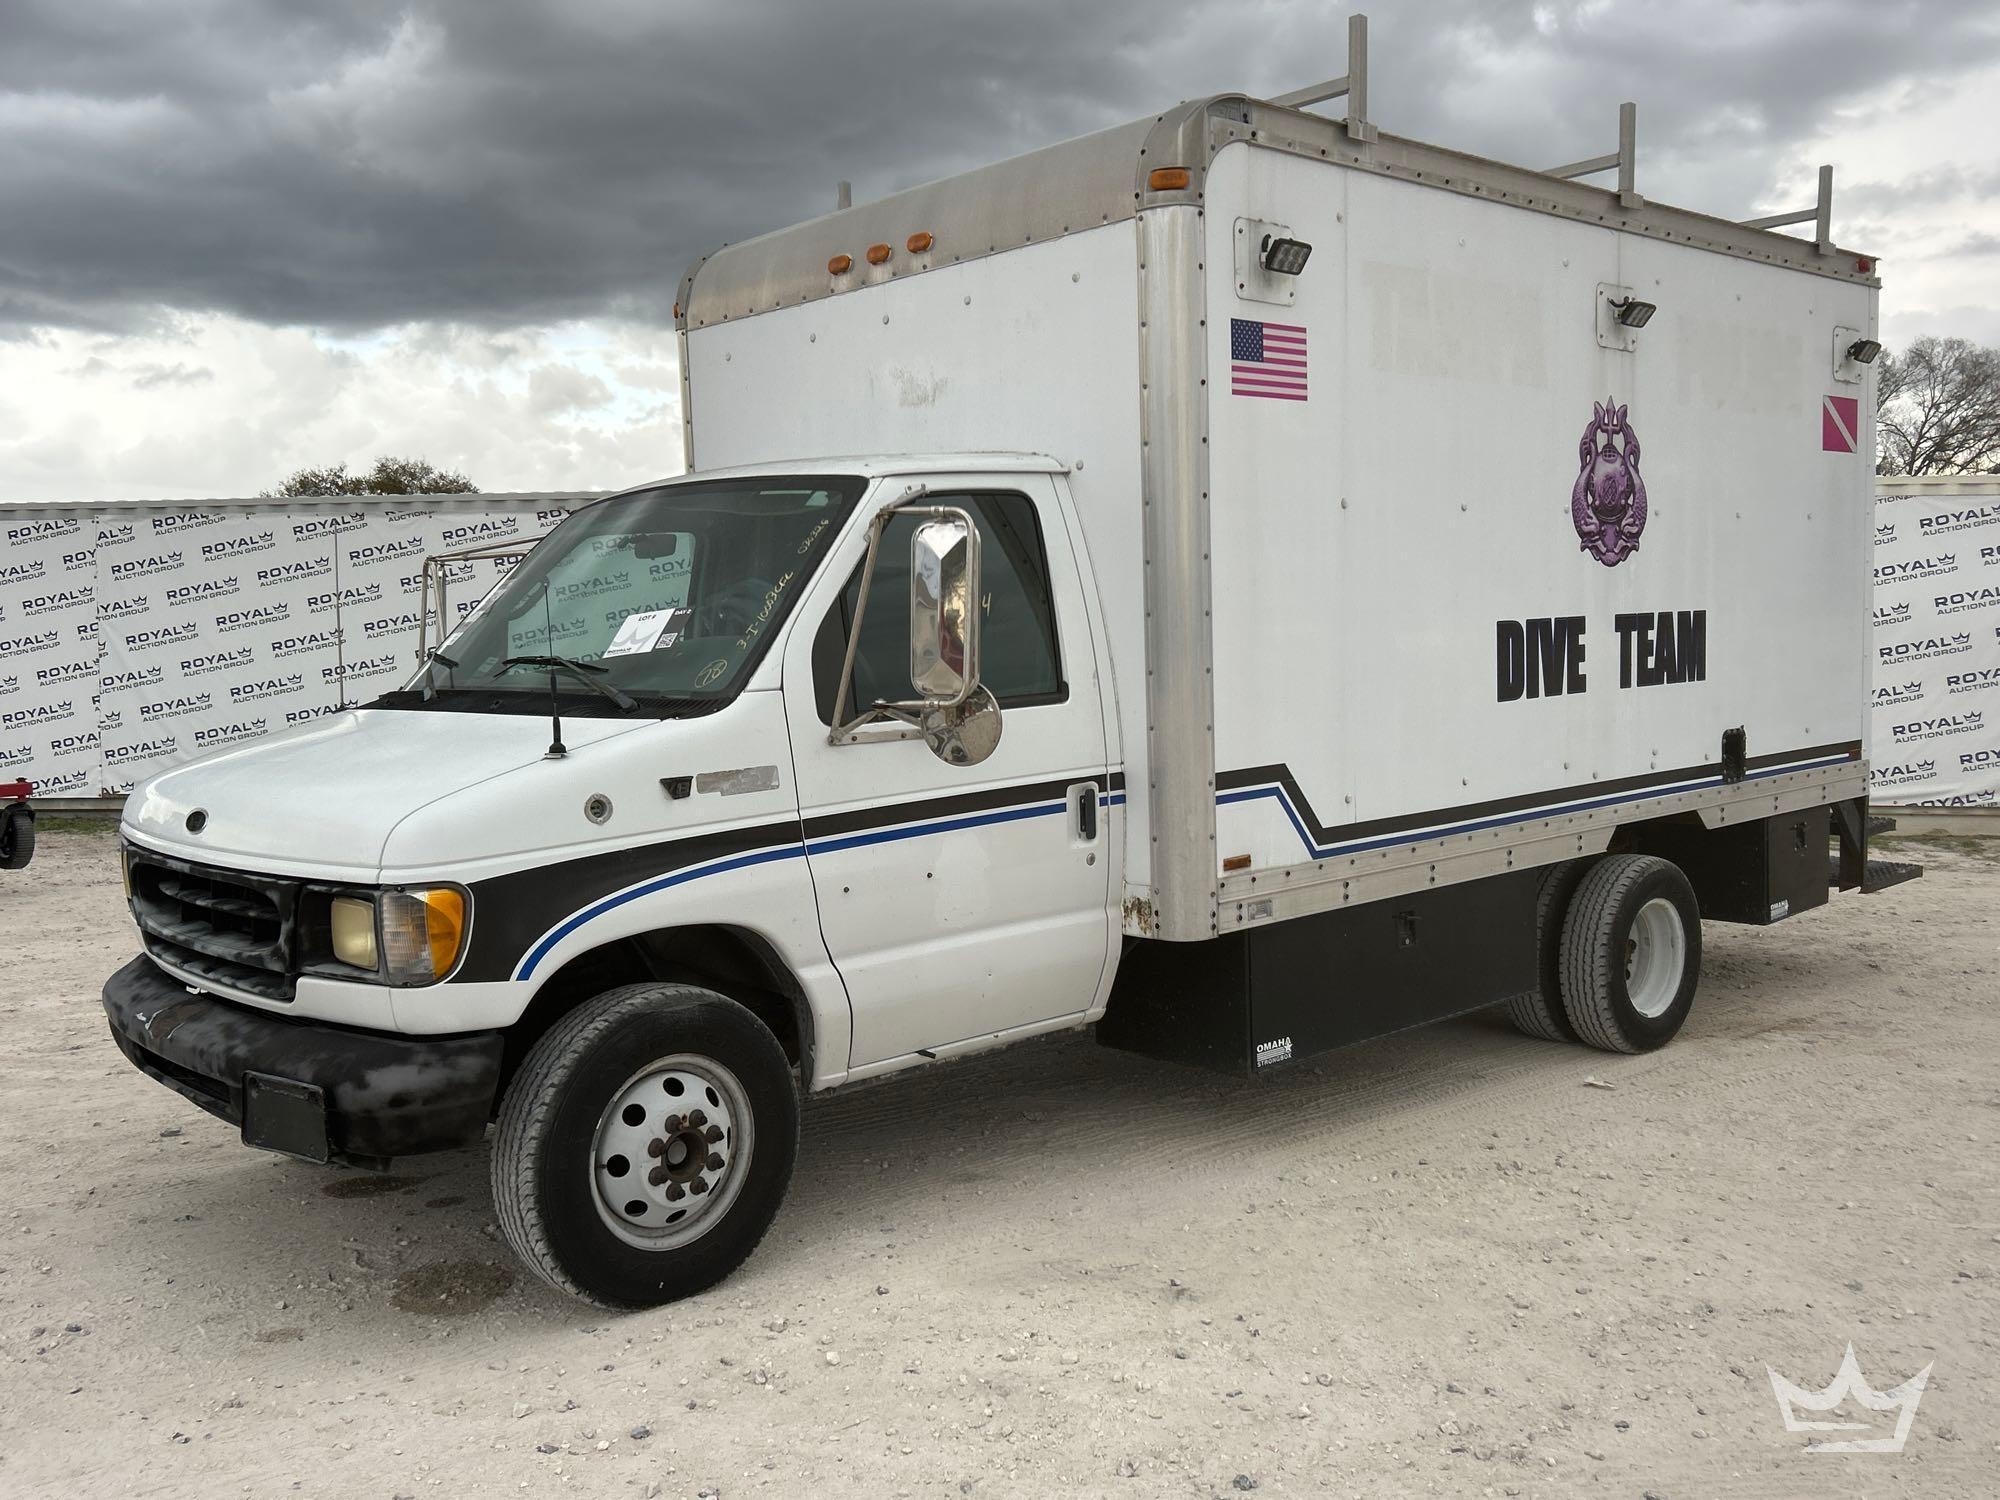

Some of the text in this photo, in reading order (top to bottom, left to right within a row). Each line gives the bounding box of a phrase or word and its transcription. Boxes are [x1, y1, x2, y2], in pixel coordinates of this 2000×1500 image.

[155, 517, 226, 536] AUCTION GROUP
[293, 516, 350, 535] ROYAL
[1920, 508, 1991, 528] ROYAL
[8, 521, 64, 539] ROYAL
[10, 527, 80, 546] AUCTION GROUP
[296, 523, 368, 543] AUCTION GROUP
[443, 520, 501, 540] ROYAL
[445, 527, 519, 547] AUCTION GROUP
[1922, 523, 1970, 536] AUCTION
[104, 536, 135, 546] GROUP
[202, 536, 259, 555] ROYAL
[349, 541, 407, 560] ROYAL
[204, 543, 276, 562] AUCTION GROUP
[352, 548, 424, 568] AUCTION GROUP
[112, 556, 168, 575] ROYAL
[114, 562, 185, 582] AUCTION GROUP
[257, 561, 314, 580] ROYAL
[650, 558, 690, 575] ROY
[16, 571, 46, 582] GROUP
[260, 568, 332, 587] AUCTION GROUP
[1874, 566, 1958, 586] UCTION GROUP
[166, 581, 223, 600] ROYAL
[555, 576, 614, 596] ROYAL
[600, 583, 632, 593] GROUP
[22, 591, 78, 609] ROYAL
[169, 587, 240, 607] AUCTION GROUP
[308, 587, 365, 606] ROYAL
[351, 594, 382, 605] GROUP
[982, 593, 991, 616] 4
[25, 597, 95, 616] AUCTION GROUP
[98, 600, 133, 614] YAL
[118, 606, 150, 618] GROUP
[1937, 602, 1985, 615] AUCTION
[216, 607, 273, 626] ROYAL
[218, 614, 290, 633] AUCTION GROUP
[364, 613, 422, 632] ROYAL
[1873, 615, 1911, 627] GROUP
[126, 626, 182, 645] ROYAL
[272, 632, 329, 651] ROYAL
[366, 627, 406, 639] AUCTION
[512, 622, 570, 642] ROYAL
[0, 635, 43, 651] OYAL
[30, 641, 60, 652] GROUP
[128, 633, 199, 652] AUCTION GROUP
[274, 646, 313, 658] AUCTION
[1880, 637, 1951, 657] ROYAL
[181, 652, 238, 670] ROYAL
[1496, 610, 1707, 702] DIVE TEAM
[1882, 645, 1971, 665] AUCTION GROUP
[37, 661, 93, 680] ROYAL
[184, 658, 255, 678] AUCTION GROUP
[366, 665, 397, 676] GROUP
[40, 675, 78, 687] AUCTION
[99, 670, 147, 688] OYAL
[134, 677, 164, 688] GROUP
[230, 678, 288, 697] ROYAL
[1949, 681, 1999, 694] AUCTION
[233, 684, 305, 704] AUCTION GROUP
[1886, 694, 1924, 705] GROUP
[3, 705, 58, 723] ROYAL
[140, 696, 197, 715] ROYAL
[143, 702, 214, 722] AUCTION GROUP
[5, 711, 75, 730] AUCTION GROUP
[1893, 716, 1964, 736] ROYAL
[195, 721, 252, 740] ROYAL
[198, 728, 269, 748] AUCTION GROUP
[1895, 724, 1984, 744] AUCTION GROUP
[51, 732, 100, 750] ROYA
[105, 740, 161, 759] ROYAL
[54, 745, 92, 757] AUCTION
[107, 747, 178, 766] AUCTION GROUP
[4, 757, 34, 768] GROUP
[58, 782, 89, 793] GROUP
[1899, 772, 1937, 784] GROUP
[1257, 1037, 1291, 1052] OMAHA
